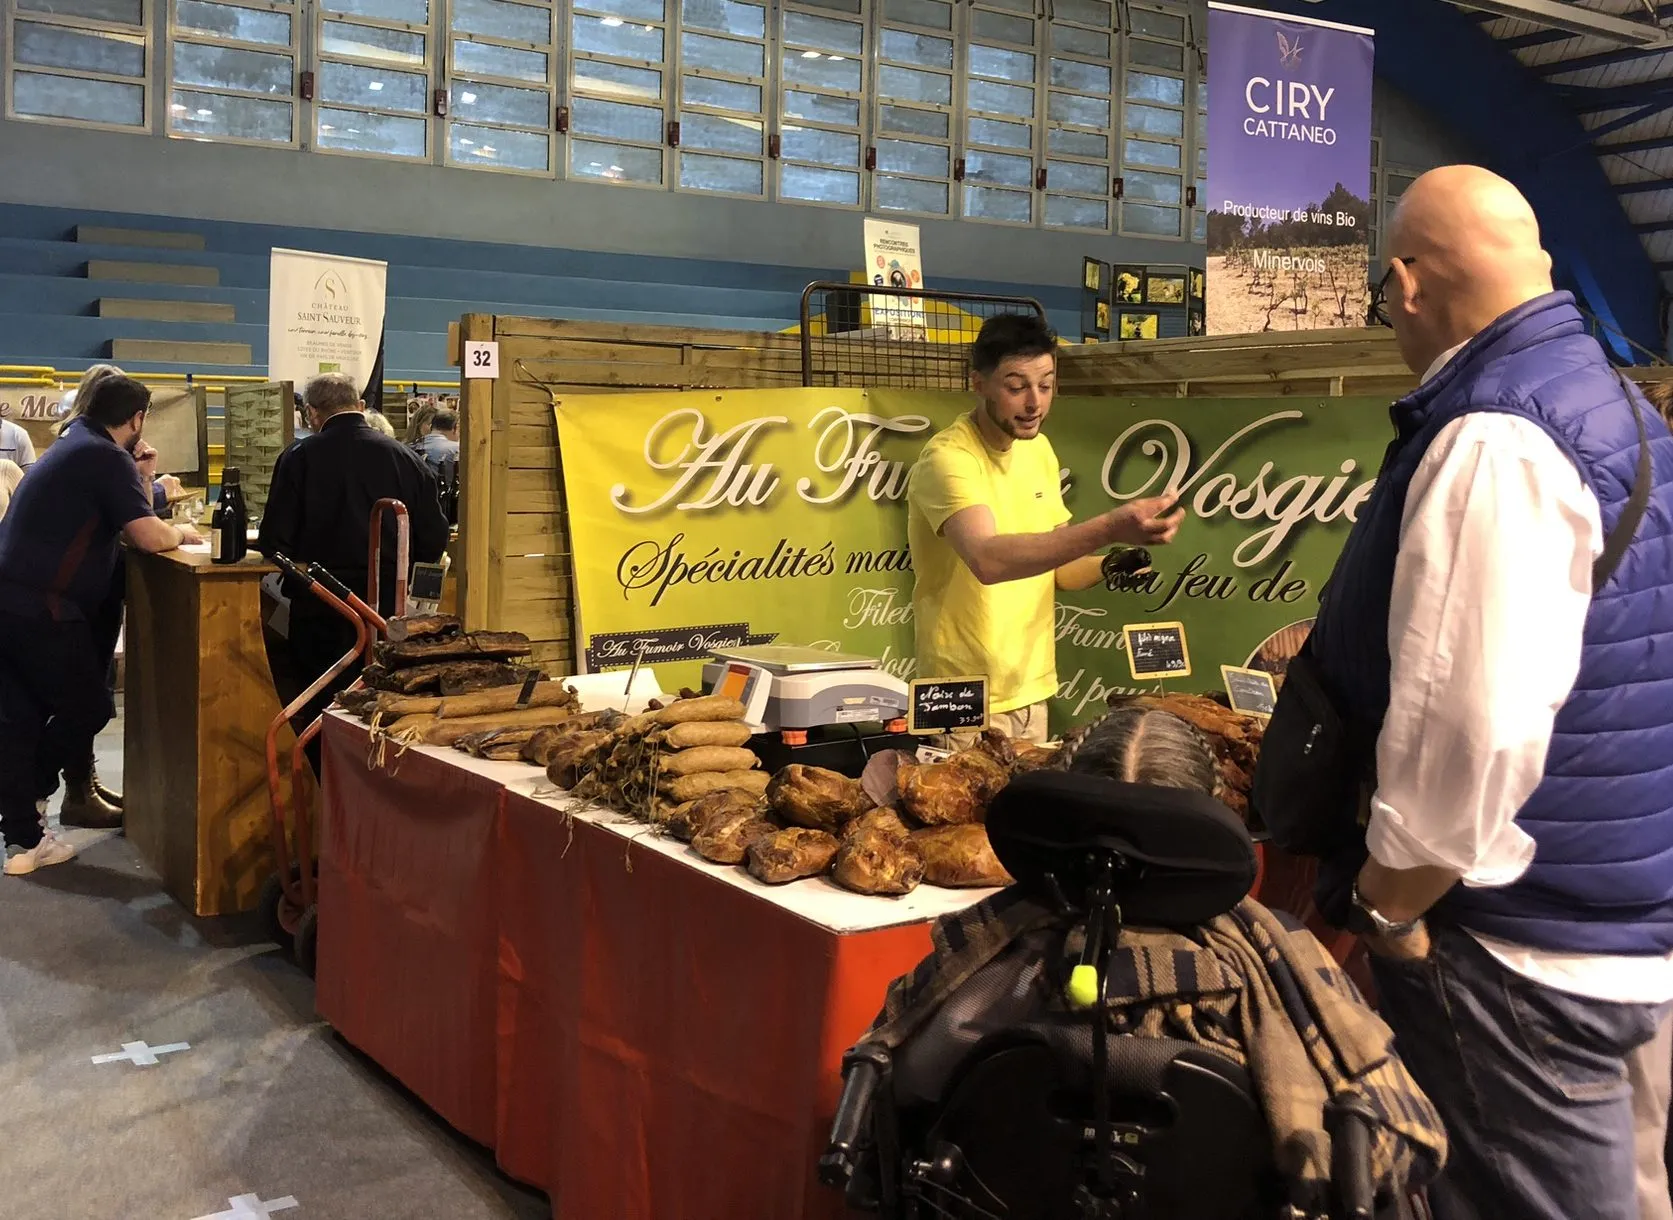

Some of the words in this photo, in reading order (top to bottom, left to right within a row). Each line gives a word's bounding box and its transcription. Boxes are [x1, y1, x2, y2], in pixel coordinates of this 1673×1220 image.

[1245, 76, 1335, 121] CIRY
[1244, 118, 1337, 145] CATTANEO
[1223, 200, 1290, 222] Producteur
[1293, 207, 1308, 223] de
[1311, 209, 1333, 226] vins
[1336, 211, 1356, 228] Bio
[1253, 250, 1326, 273] Minervois
[297, 311, 321, 322] SAINT
[322, 312, 361, 325] SAUVEUR
[312, 302, 348, 311] CHÂTEAU
[473, 350, 491, 367] 32
[610, 407, 788, 513] Au
[797, 405, 931, 504] Fu
[1101, 410, 1378, 568] Vosgie
[617, 532, 835, 607] Spécialités
[845, 543, 914, 574] mai
[1145, 553, 1238, 612] feu
[1248, 560, 1307, 603] de
[843, 587, 914, 629] Filet
[1054, 601, 1127, 650] Fum
[597, 639, 630, 658] Au
[630, 637, 684, 656] Fumoir
[959, 687, 975, 698] de
[919, 702, 973, 712] Jambon
